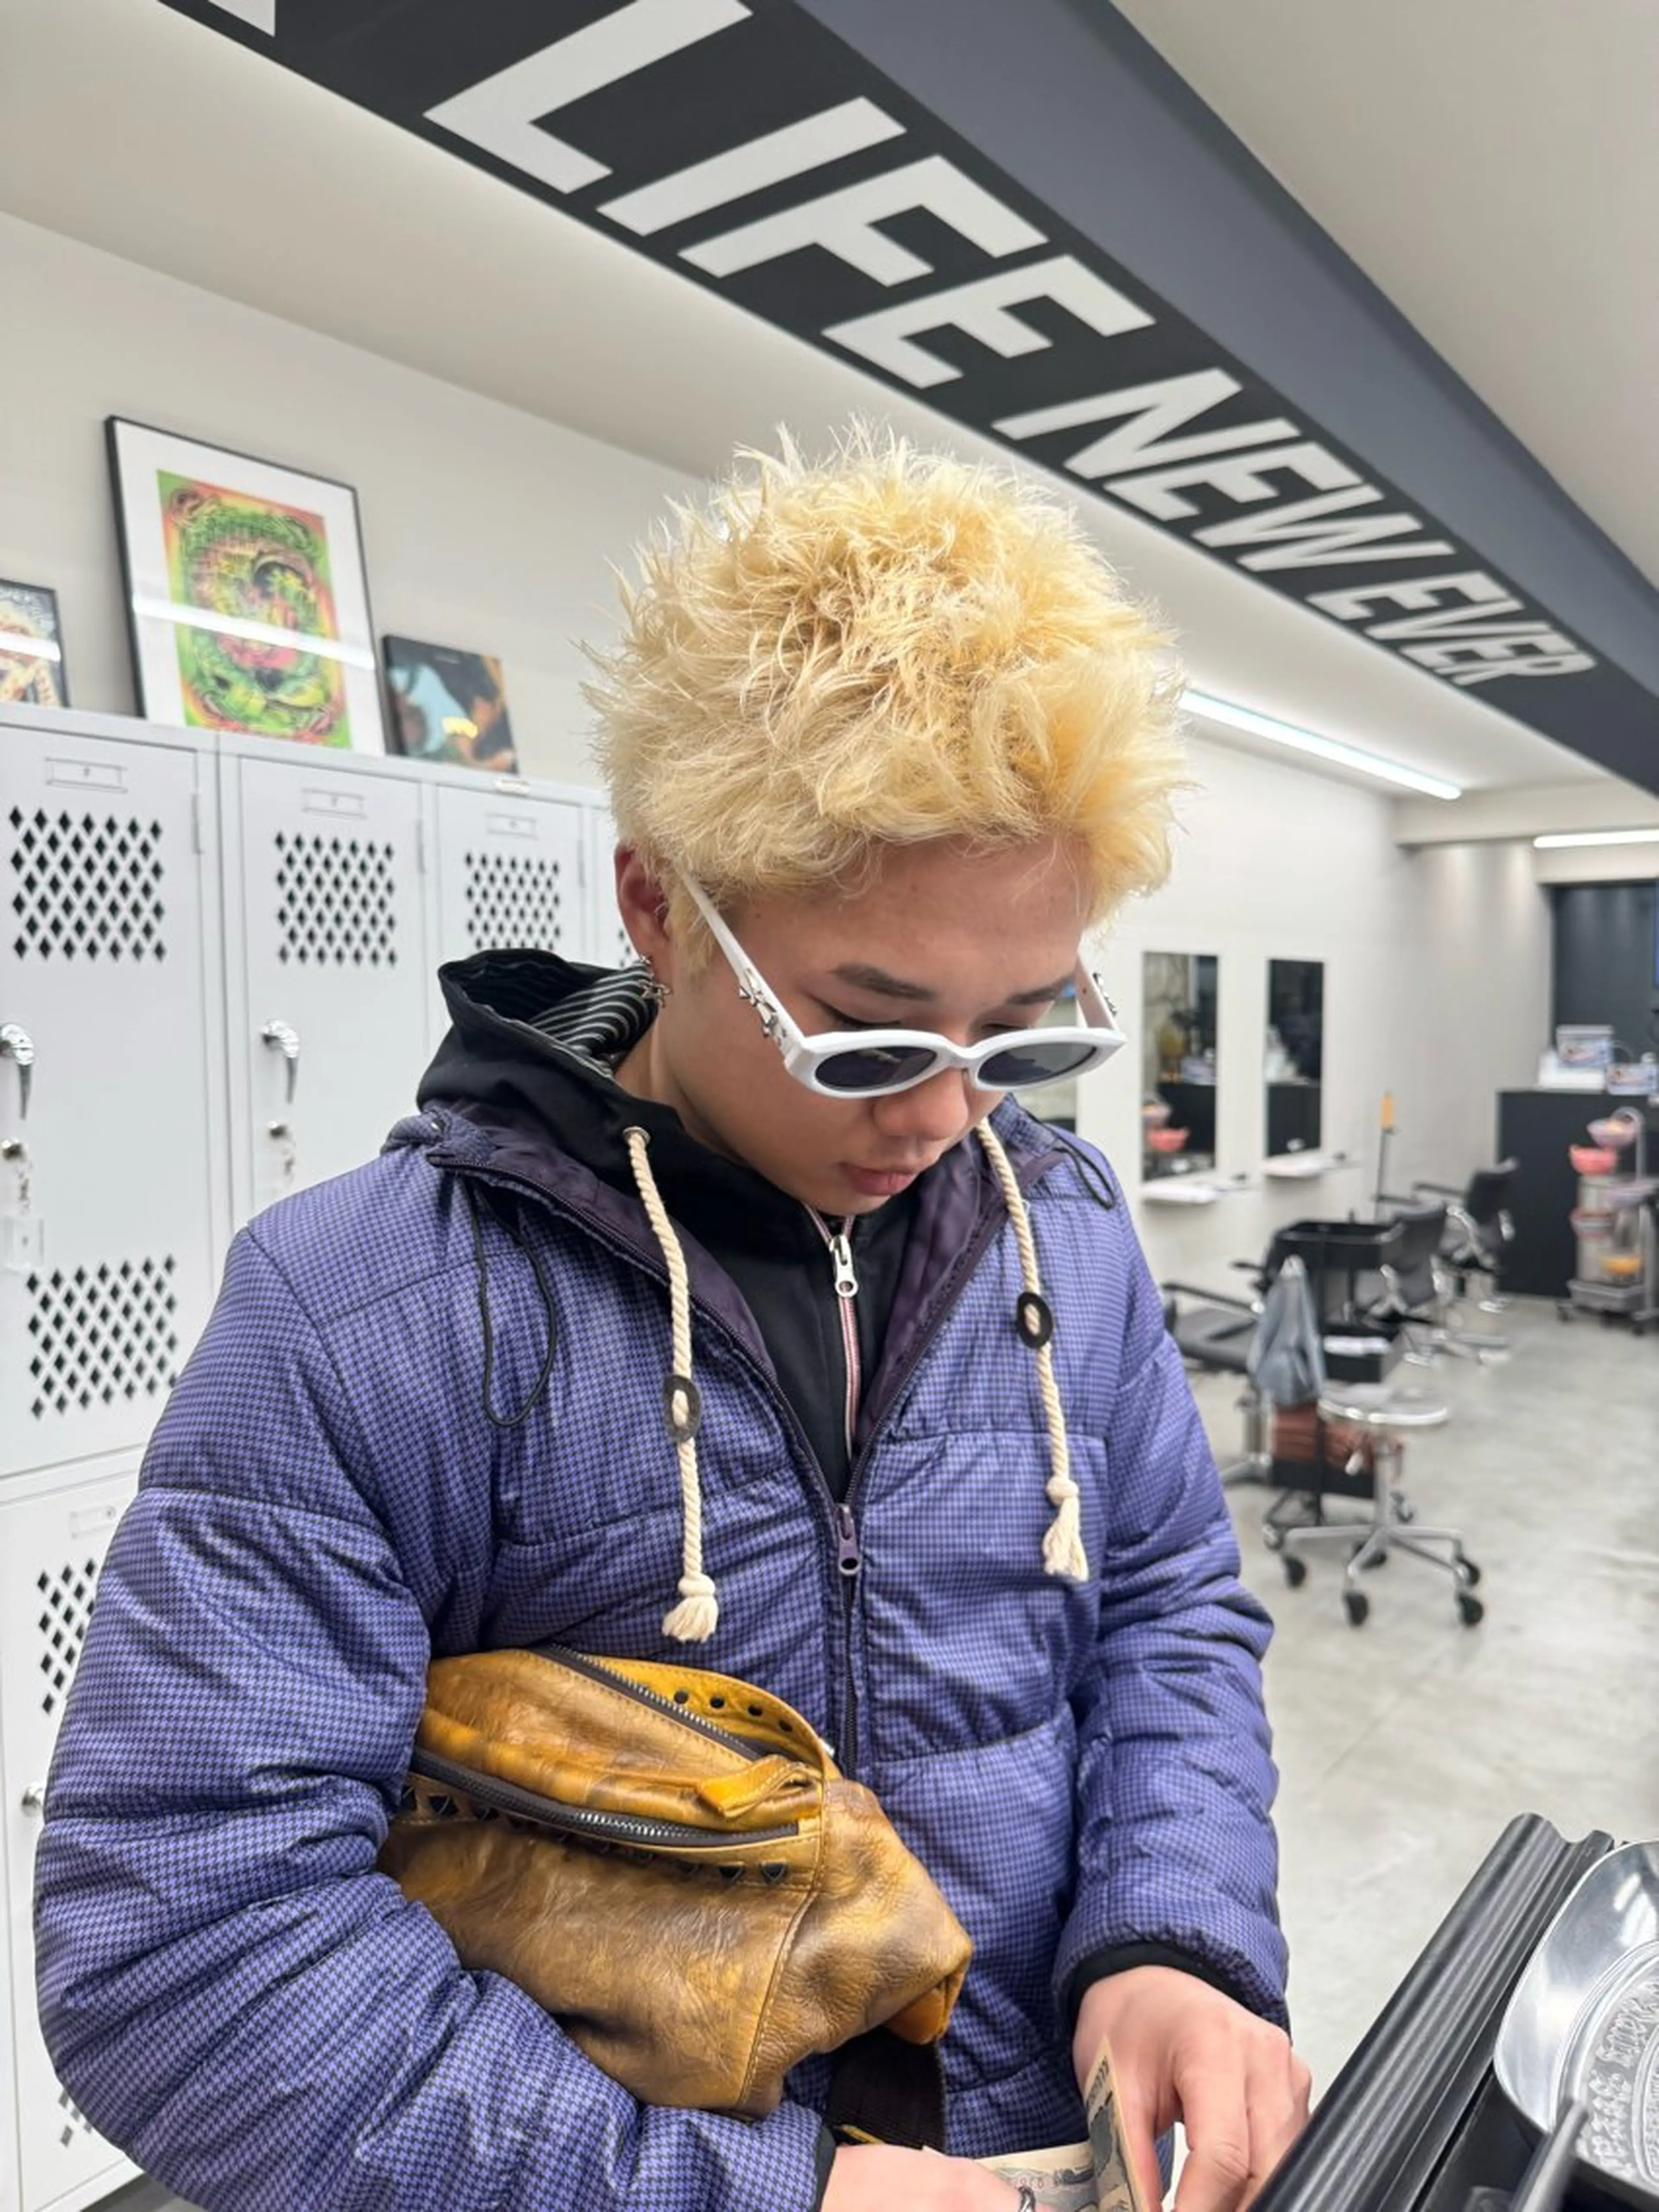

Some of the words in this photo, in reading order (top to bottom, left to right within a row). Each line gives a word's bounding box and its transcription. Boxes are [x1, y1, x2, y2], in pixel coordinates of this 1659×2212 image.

[424, 0, 1154, 388] LIFE
[992, 368, 1454, 572] NEW
[1305, 570, 1597, 686] EVER
